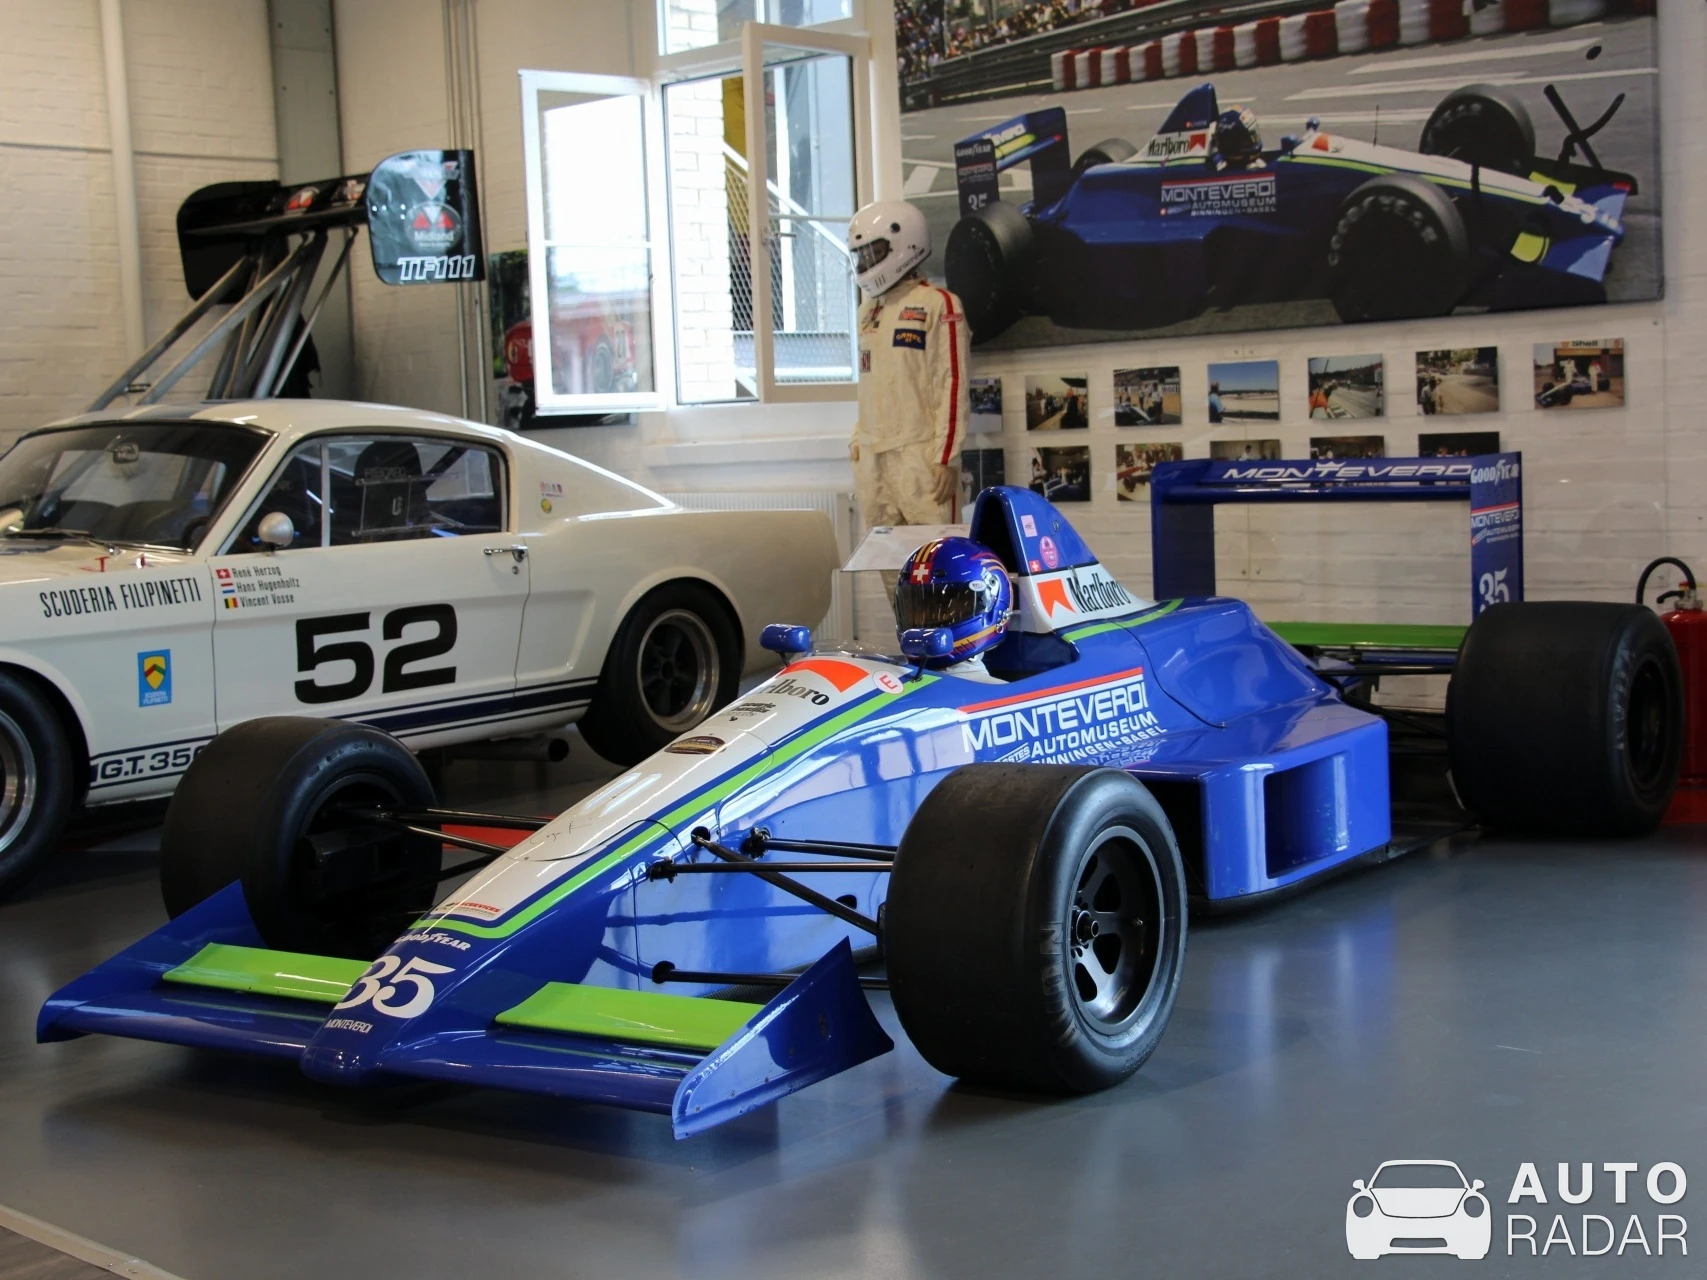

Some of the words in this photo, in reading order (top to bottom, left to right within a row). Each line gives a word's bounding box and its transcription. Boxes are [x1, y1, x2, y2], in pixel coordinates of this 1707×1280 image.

[1147, 136, 1190, 156] Marlboro
[1161, 181, 1276, 202] MONTEVERDI
[1191, 196, 1276, 210] AUTOMUSEUM
[1222, 461, 1472, 479] MONTEVERD
[253, 566, 281, 577] Herzog
[236, 580, 256, 593] Hans
[257, 577, 300, 591] Hugenholtz
[1066, 573, 1131, 613] Marlboro
[40, 586, 117, 618] SCUDERIA
[120, 577, 202, 609] FILIPINETTI
[240, 595, 269, 608] Vincent
[271, 593, 295, 605] Vosse
[295, 603, 458, 704] 52
[960, 682, 1149, 753] MONTEVERDI
[1031, 711, 1159, 758] AUTOMUSEUM
[101, 754, 146, 780] G.T.
[334, 955, 457, 1018] 35
[323, 1018, 374, 1034] MONTEVERDI
